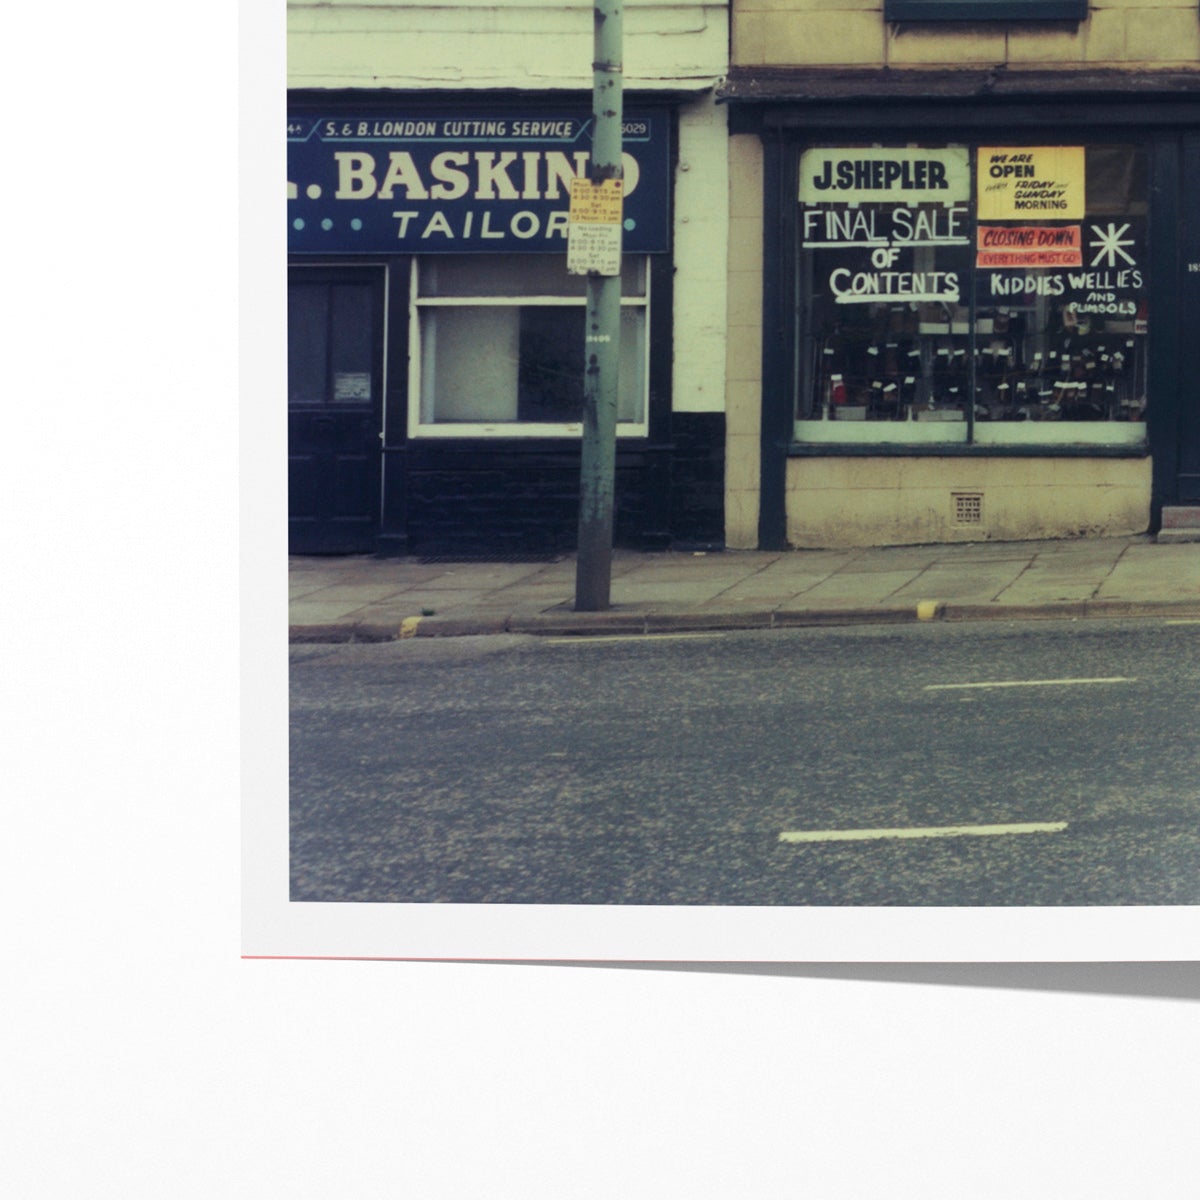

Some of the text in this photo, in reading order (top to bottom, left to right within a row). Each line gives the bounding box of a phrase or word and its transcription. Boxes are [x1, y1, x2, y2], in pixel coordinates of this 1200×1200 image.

[443, 121, 506, 136] CUTTING
[512, 121, 573, 136] SERVICE
[1009, 153, 1034, 163] ARE
[990, 165, 1035, 178] OPEN
[1015, 180, 1055, 189] FRIDAY
[1015, 190, 1066, 199] SUNDAY
[1014, 200, 1068, 210] MORNING
[803, 207, 969, 241] FINAL SALE
[983, 230, 1075, 247] CLOSING DOWN
[871, 248, 901, 269] OF
[983, 254, 1037, 265] EVERYTHING
[829, 268, 959, 297] CONTENTS
[991, 273, 1065, 296] KIDDIES
[1086, 292, 1116, 302] AND
